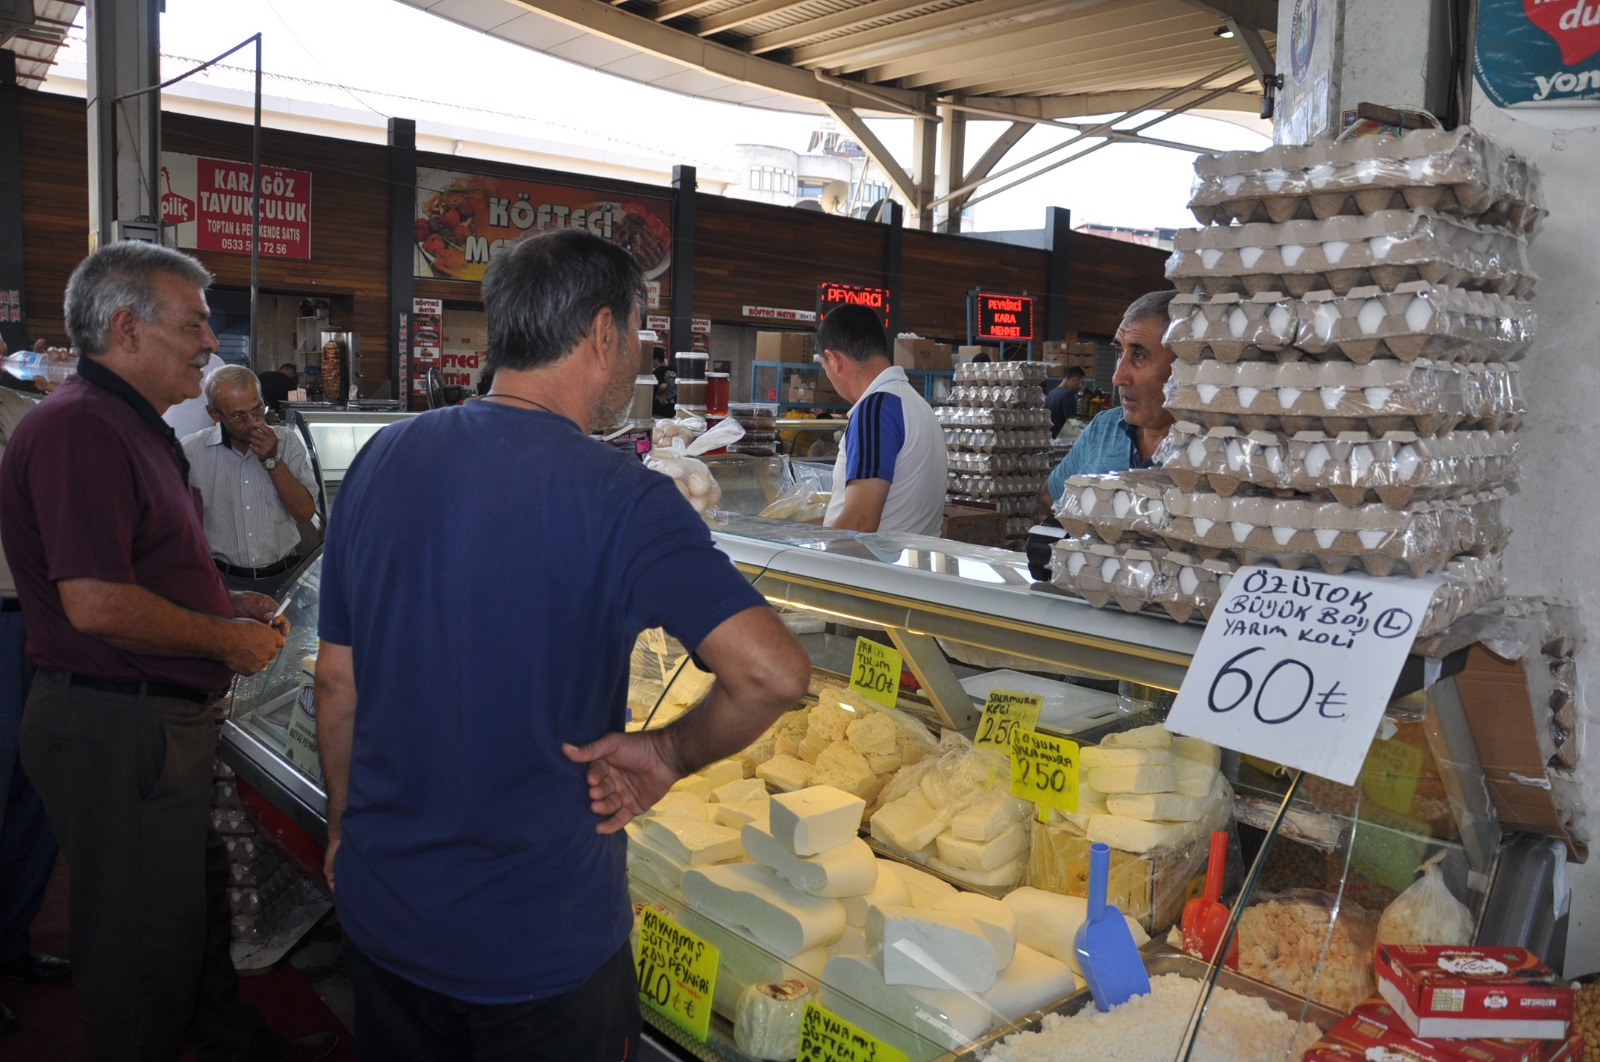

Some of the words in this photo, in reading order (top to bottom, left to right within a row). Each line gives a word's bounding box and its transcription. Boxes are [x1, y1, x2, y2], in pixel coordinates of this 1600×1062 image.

[207, 219, 234, 235] TOPTAN
[235, 225, 241, 235] &
[281, 228, 300, 244] SATIŞ
[221, 238, 243, 250] 0533
[263, 242, 275, 253] 72
[276, 243, 287, 254] 56
[990, 326, 1021, 336] MEHMET
[994, 313, 1017, 324] KARA
[1225, 595, 1312, 622] BÜYÜK
[1317, 607, 1369, 633] BOY
[1223, 618, 1288, 637] YARIM
[1298, 629, 1356, 649] KOLİ
[643, 911, 705, 961] KAYNAMIŞ
[641, 945, 665, 968] KÖY
[804, 1005, 877, 1061] KAYNAMIŞ
